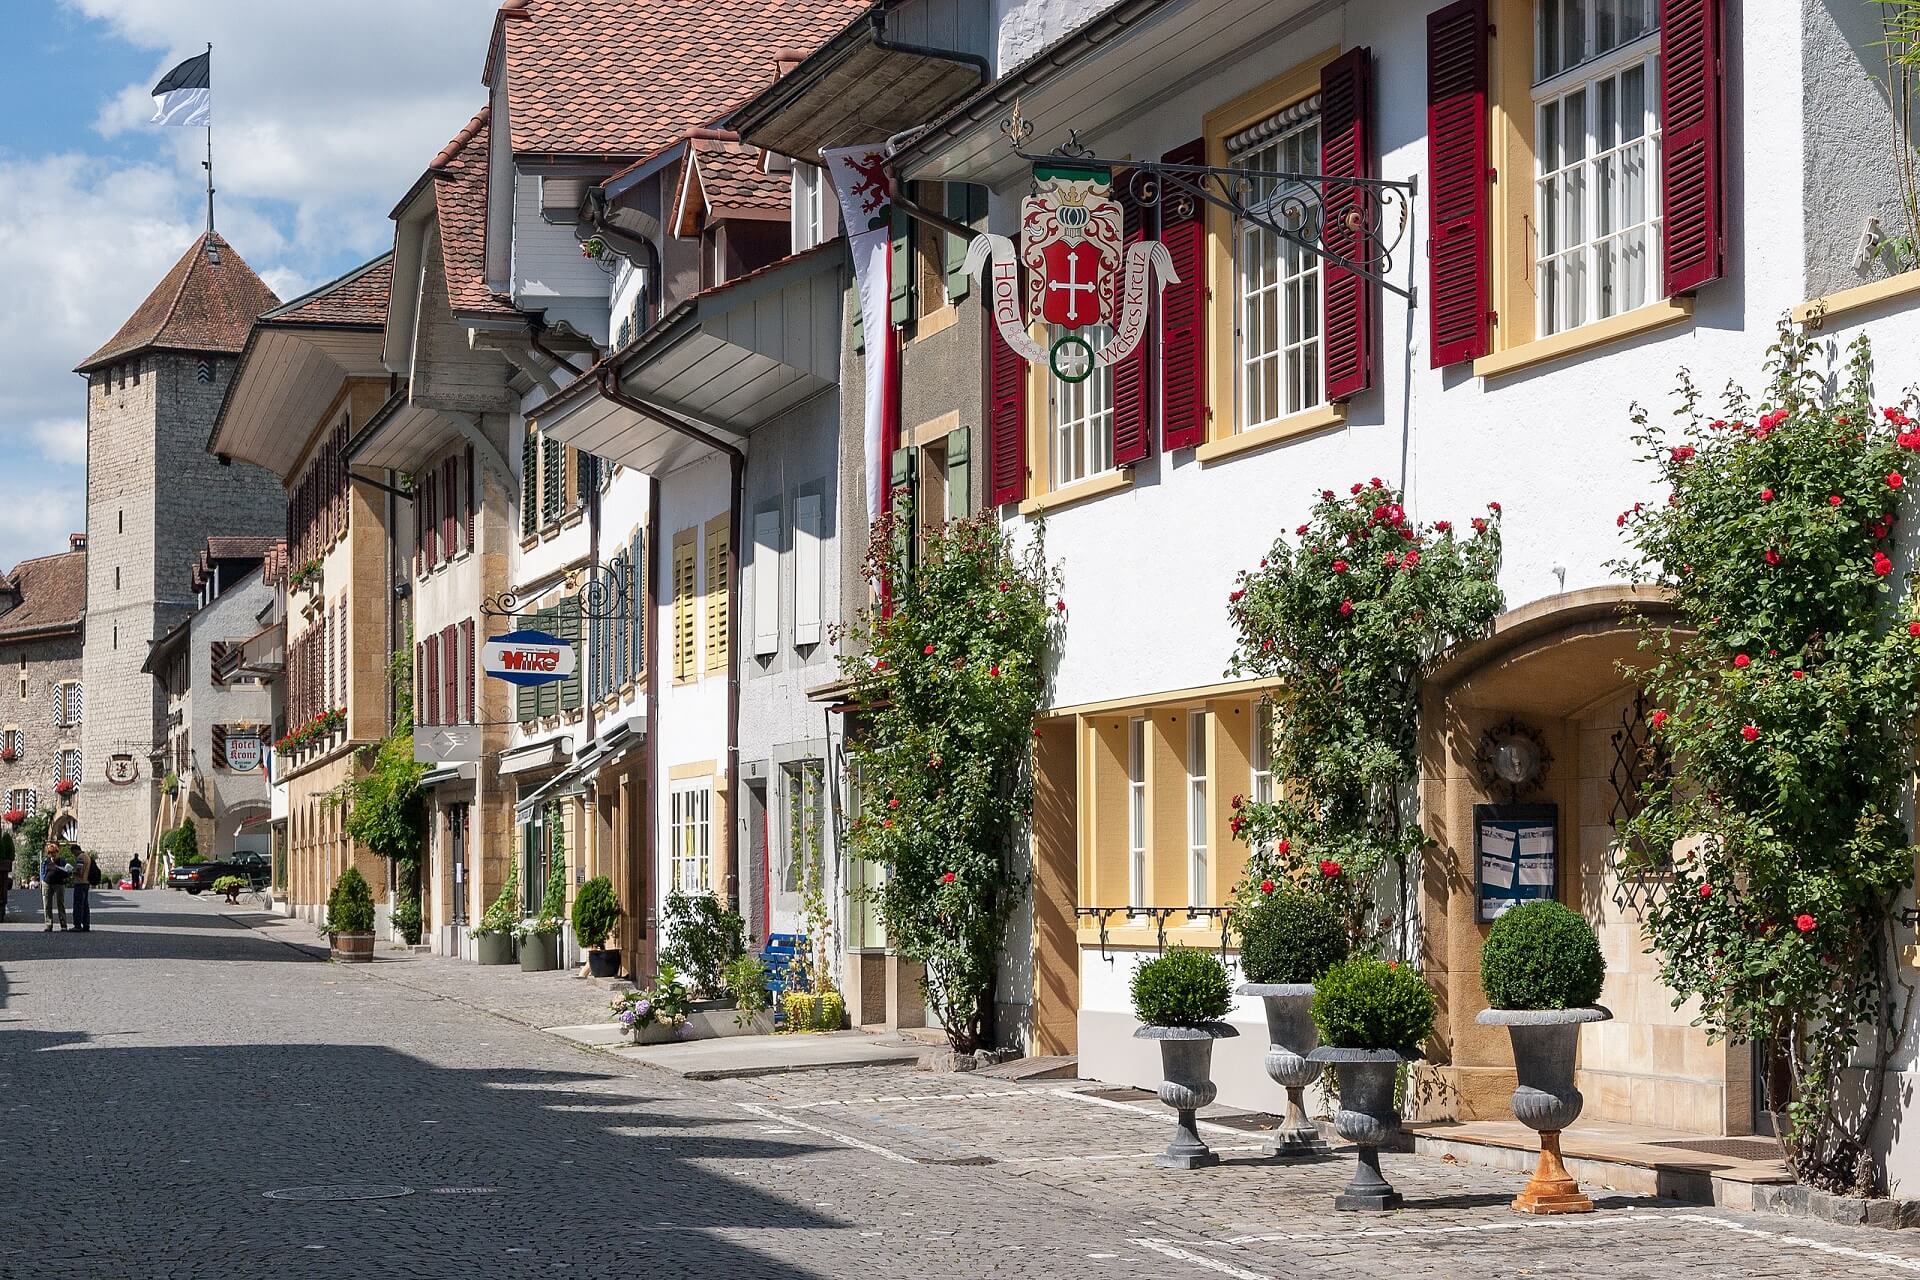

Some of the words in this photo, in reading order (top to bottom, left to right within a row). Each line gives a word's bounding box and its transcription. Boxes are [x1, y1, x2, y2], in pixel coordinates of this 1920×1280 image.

[994, 262, 1019, 325] Hotel
[1096, 308, 1142, 364] Weisses
[1127, 251, 1146, 306] Kreuz
[503, 650, 557, 671] Wilke
[230, 750, 257, 760] Krone
[231, 740, 256, 750] Hotel
